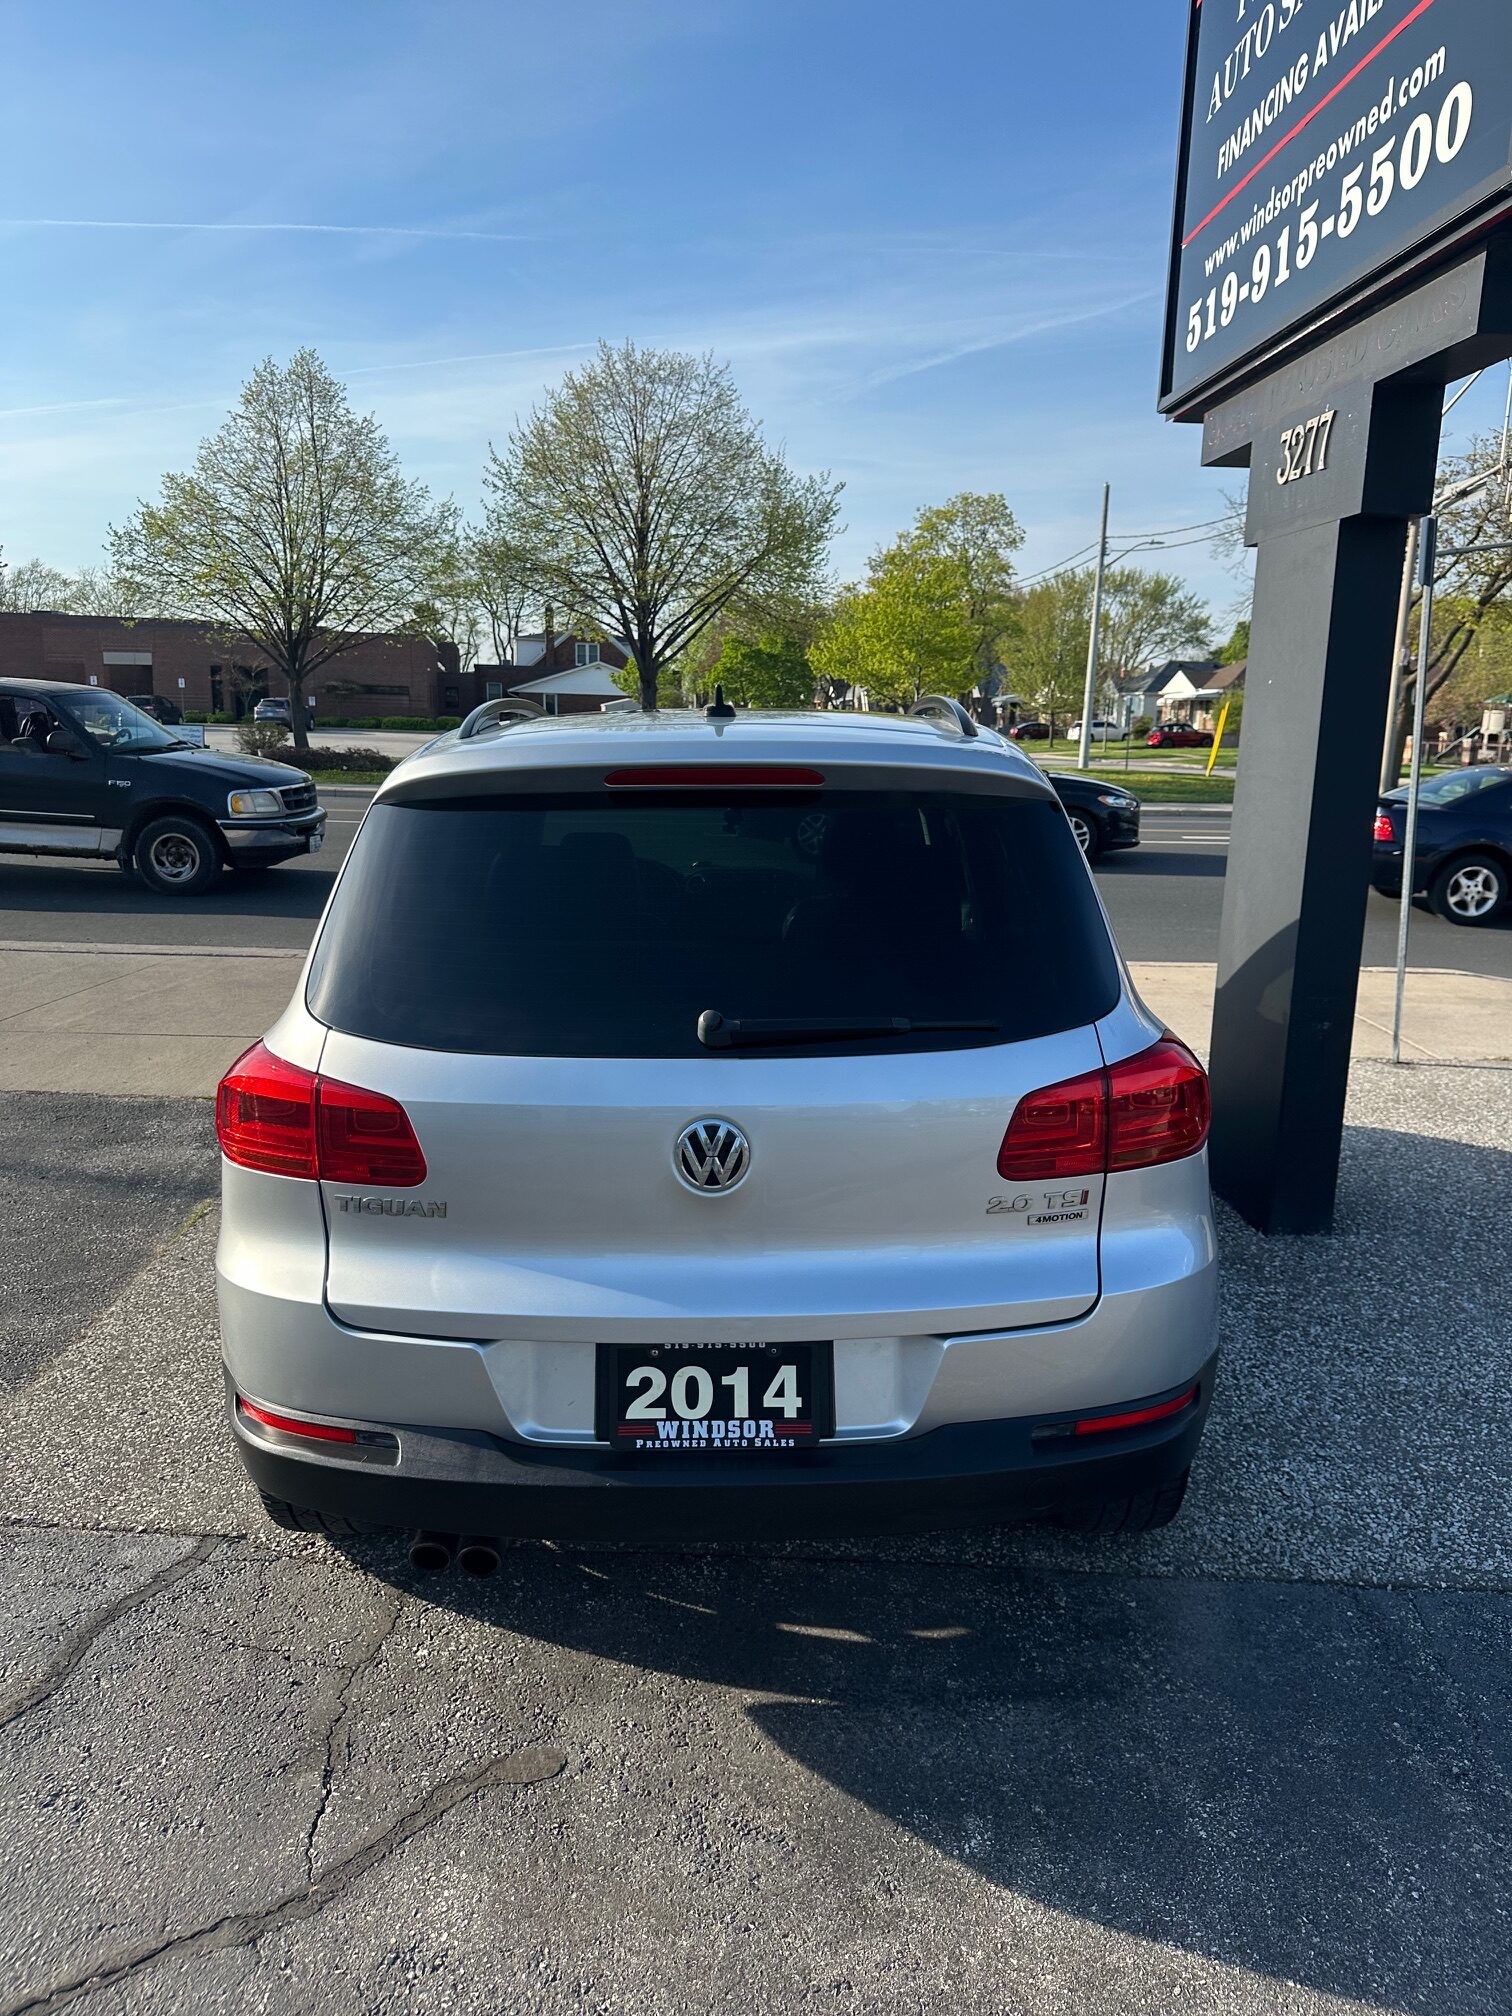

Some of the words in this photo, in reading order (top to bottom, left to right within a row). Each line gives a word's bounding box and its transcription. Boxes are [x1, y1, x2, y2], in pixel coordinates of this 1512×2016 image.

[1205, 3, 1275, 124] AUTO
[1278, 0, 1305, 34] S
[1217, 53, 1309, 180] FINANCING
[1203, 46, 1447, 278] www.windsorpreowned.com
[1185, 81, 1474, 353] 519-915-5500
[1276, 410, 1336, 485] 3277
[334, 1194, 448, 1219] TIGUAN
[1034, 1211, 1083, 1224] 4MOTION
[1044, 1188, 1090, 1209] TSI
[625, 1364, 803, 1420] 2014
[656, 1419, 775, 1439] WINDSOR
